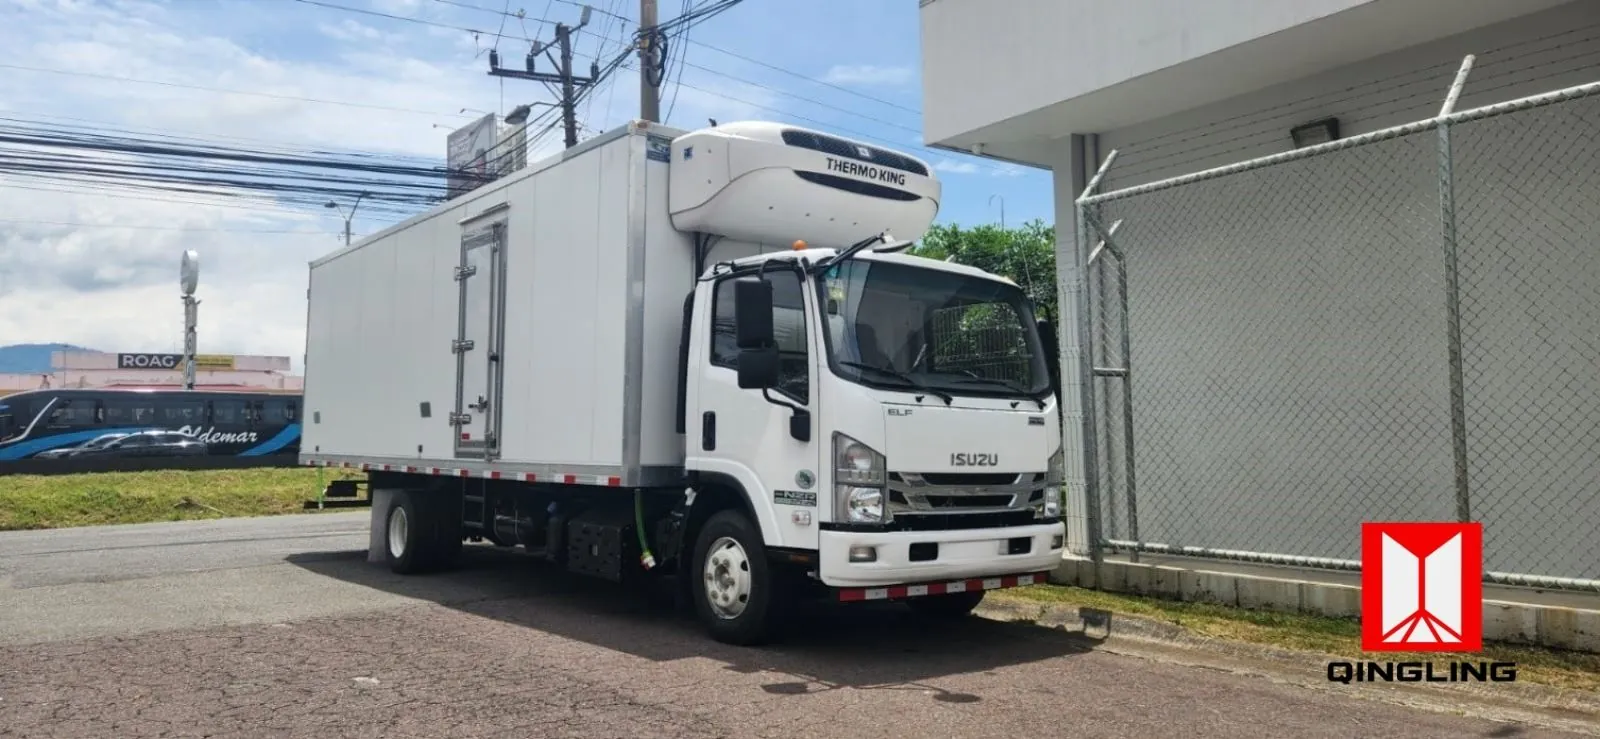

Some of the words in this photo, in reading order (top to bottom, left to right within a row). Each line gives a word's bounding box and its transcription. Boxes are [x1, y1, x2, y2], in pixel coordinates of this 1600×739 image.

[826, 157, 878, 179] THERMO
[879, 169, 905, 186] KING
[122, 354, 175, 367] ROAG
[887, 408, 913, 417] ELF
[950, 452, 999, 467] ISUZU
